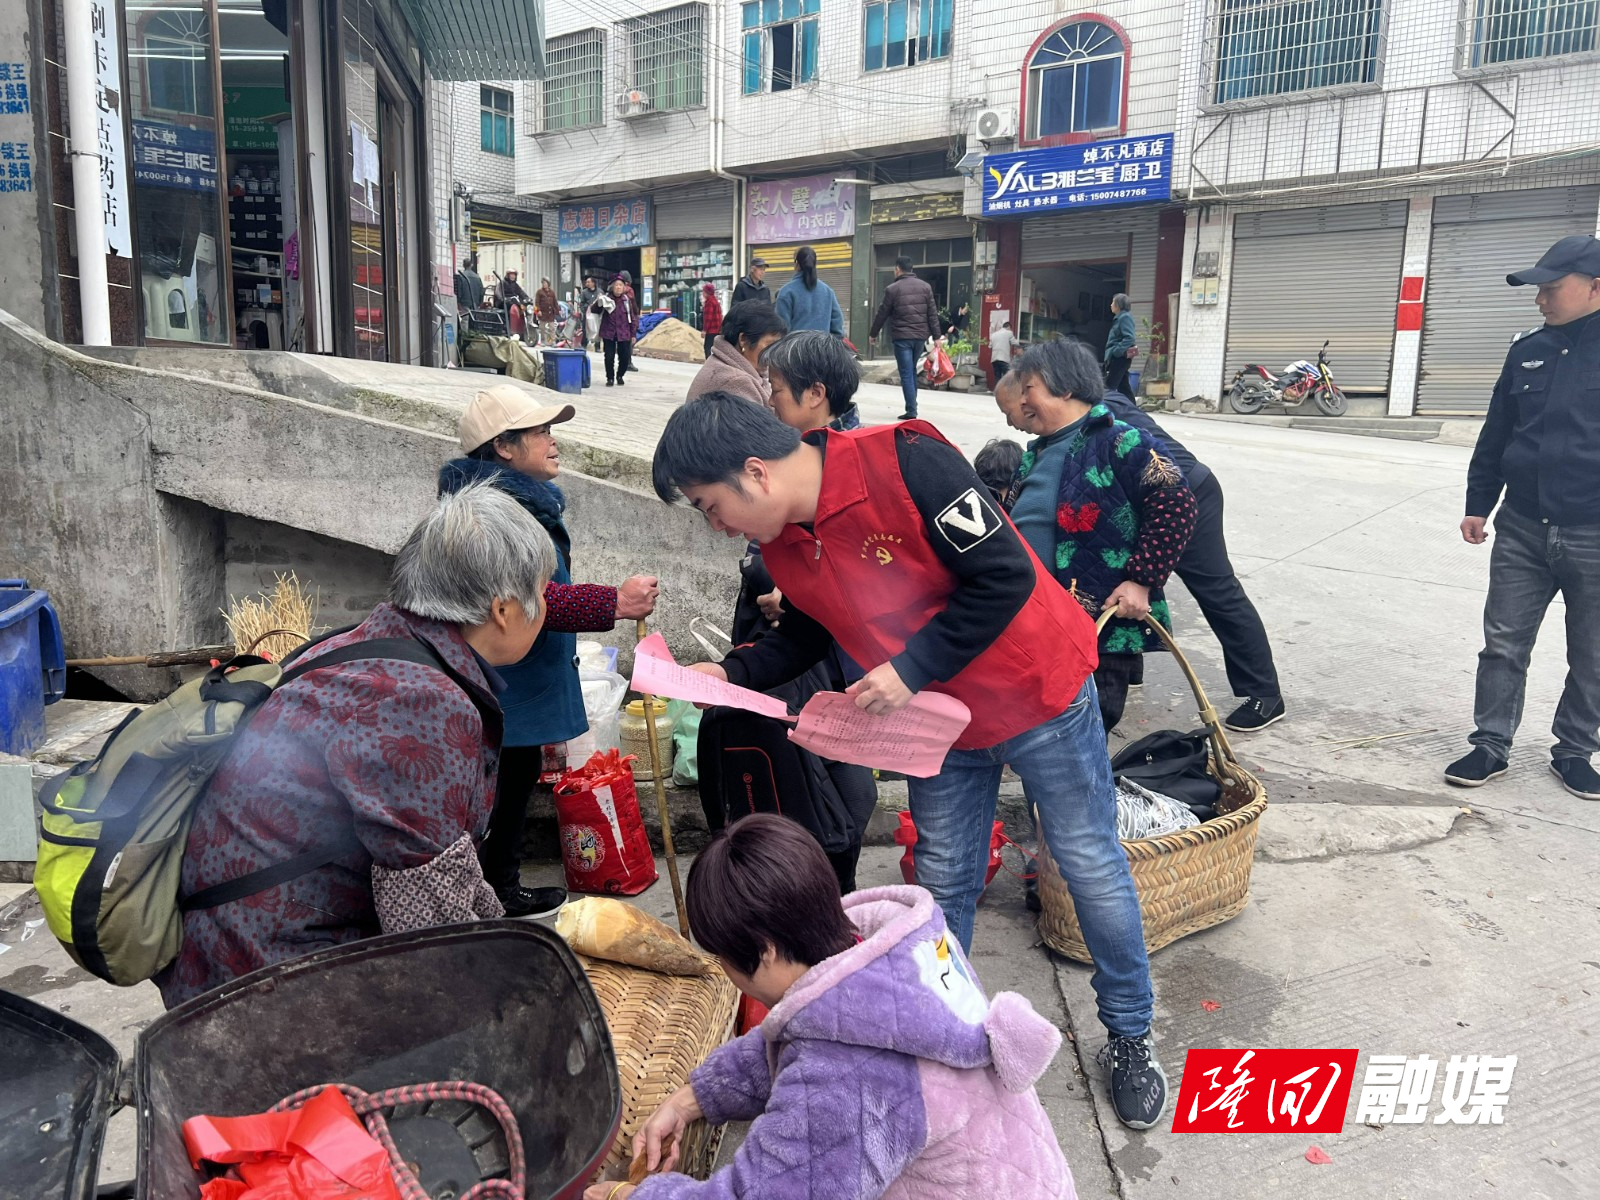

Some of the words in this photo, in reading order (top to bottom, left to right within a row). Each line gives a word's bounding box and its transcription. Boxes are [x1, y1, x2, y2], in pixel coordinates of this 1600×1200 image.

[562, 200, 646, 232] 志雄日杂店
[798, 211, 836, 229] 内衣店
